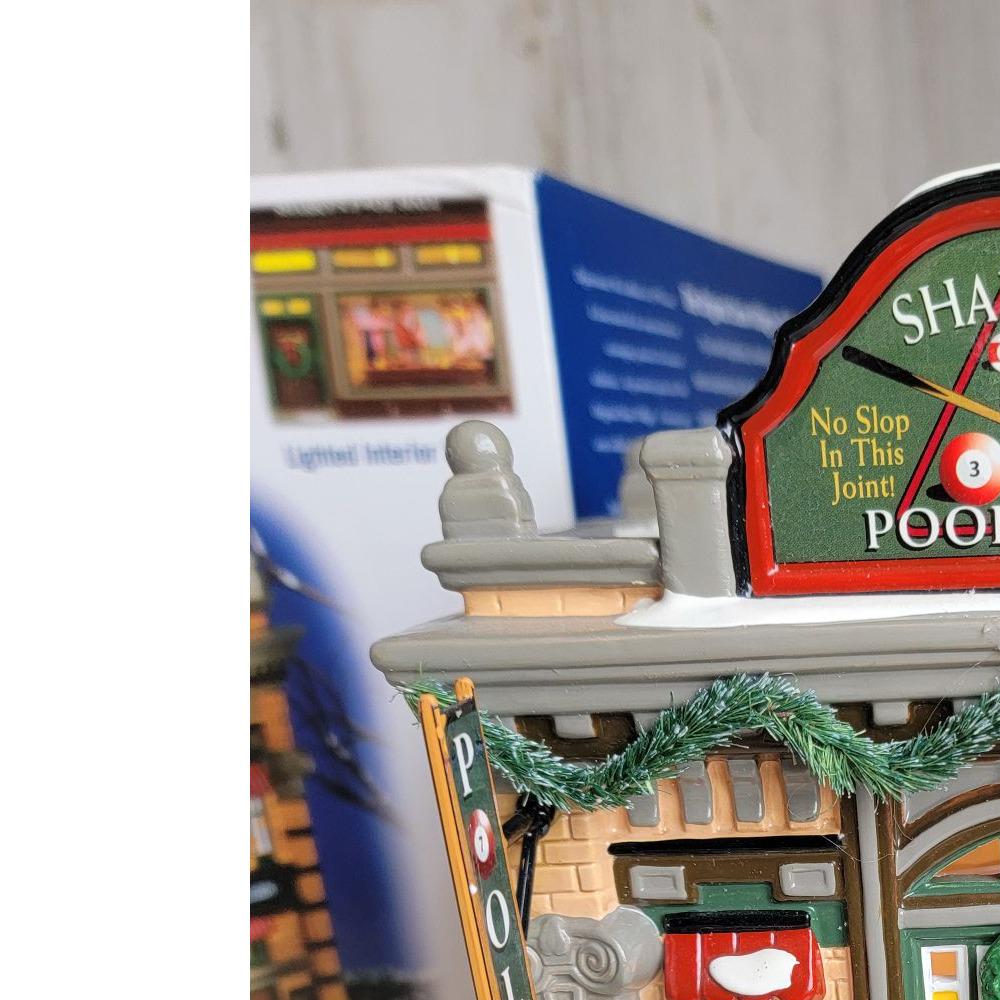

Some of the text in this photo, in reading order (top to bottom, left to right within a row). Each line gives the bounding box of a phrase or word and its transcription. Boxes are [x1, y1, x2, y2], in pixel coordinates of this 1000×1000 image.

[811, 405, 910, 441] No Slop
[820, 438, 904, 468] In This
[969, 461, 980, 477] 3
[831, 471, 895, 506] Joint!
